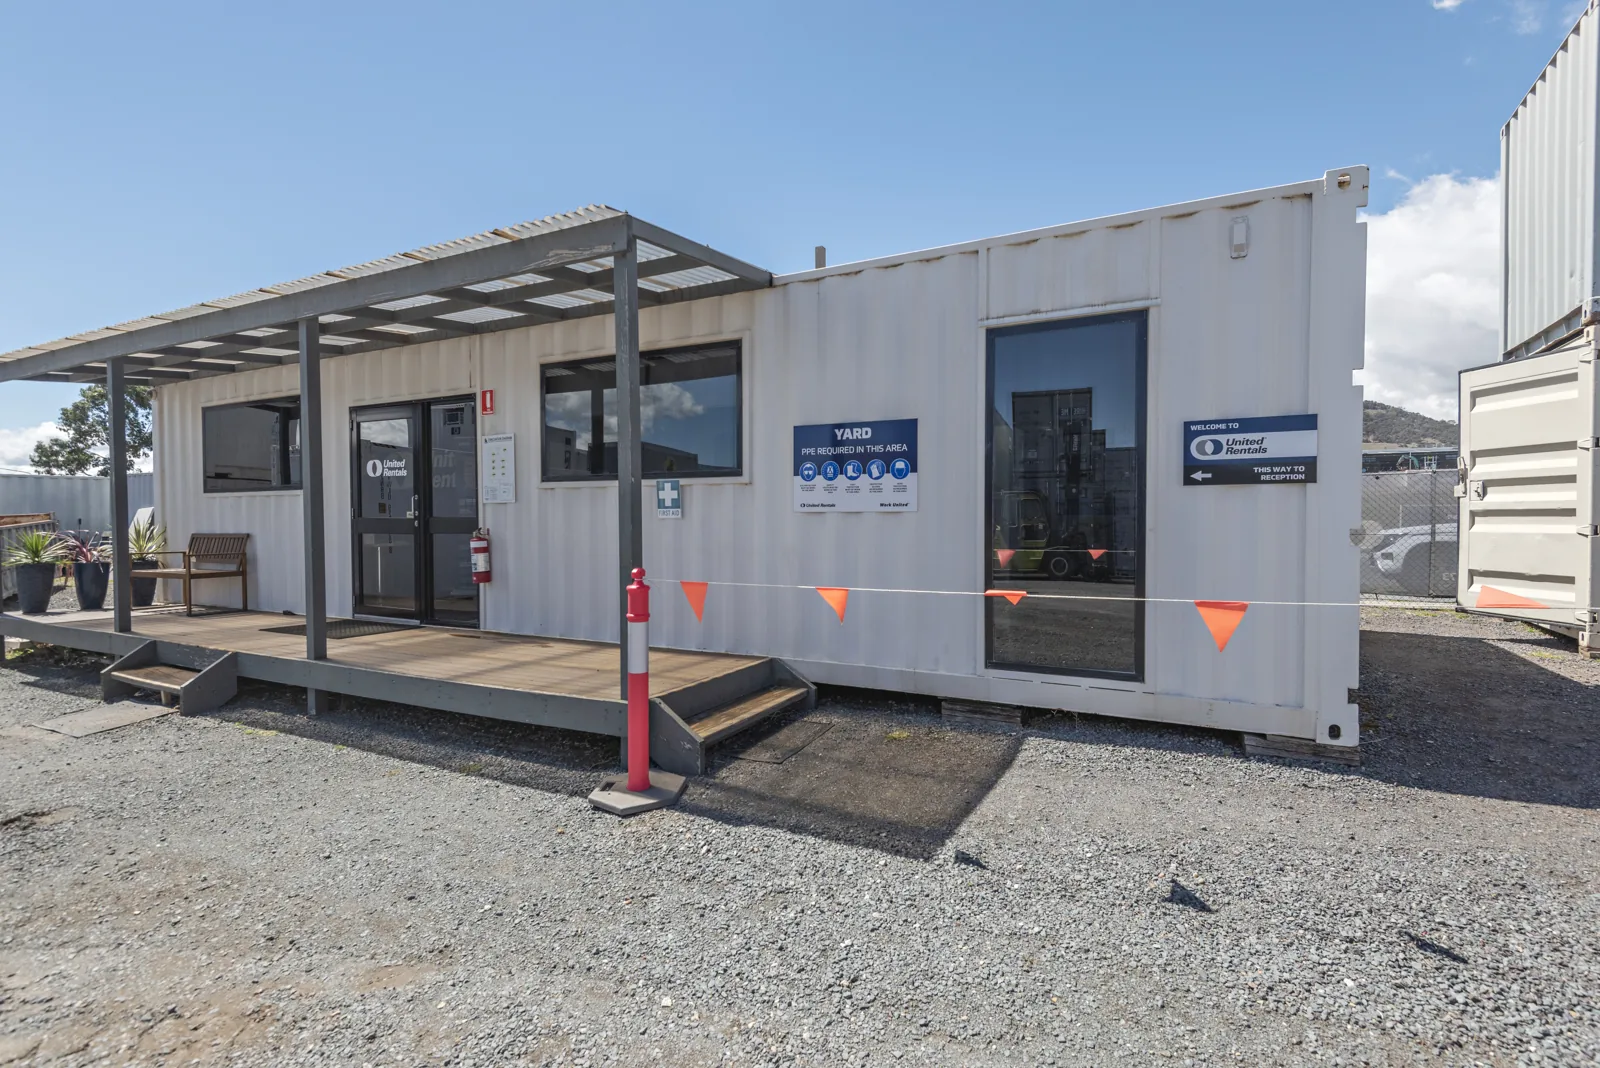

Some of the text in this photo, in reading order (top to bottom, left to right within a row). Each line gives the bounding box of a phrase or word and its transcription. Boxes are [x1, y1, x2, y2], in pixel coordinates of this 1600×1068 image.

[1190, 422, 1240, 431] WELCOME TO
[834, 427, 872, 441] YARD
[1225, 437, 1264, 446] United
[801, 443, 908, 456] PPE REQUIRED IN THIS AREA
[1225, 446, 1268, 455] Rentals
[383, 459, 406, 468] United
[383, 468, 408, 477] Rentals
